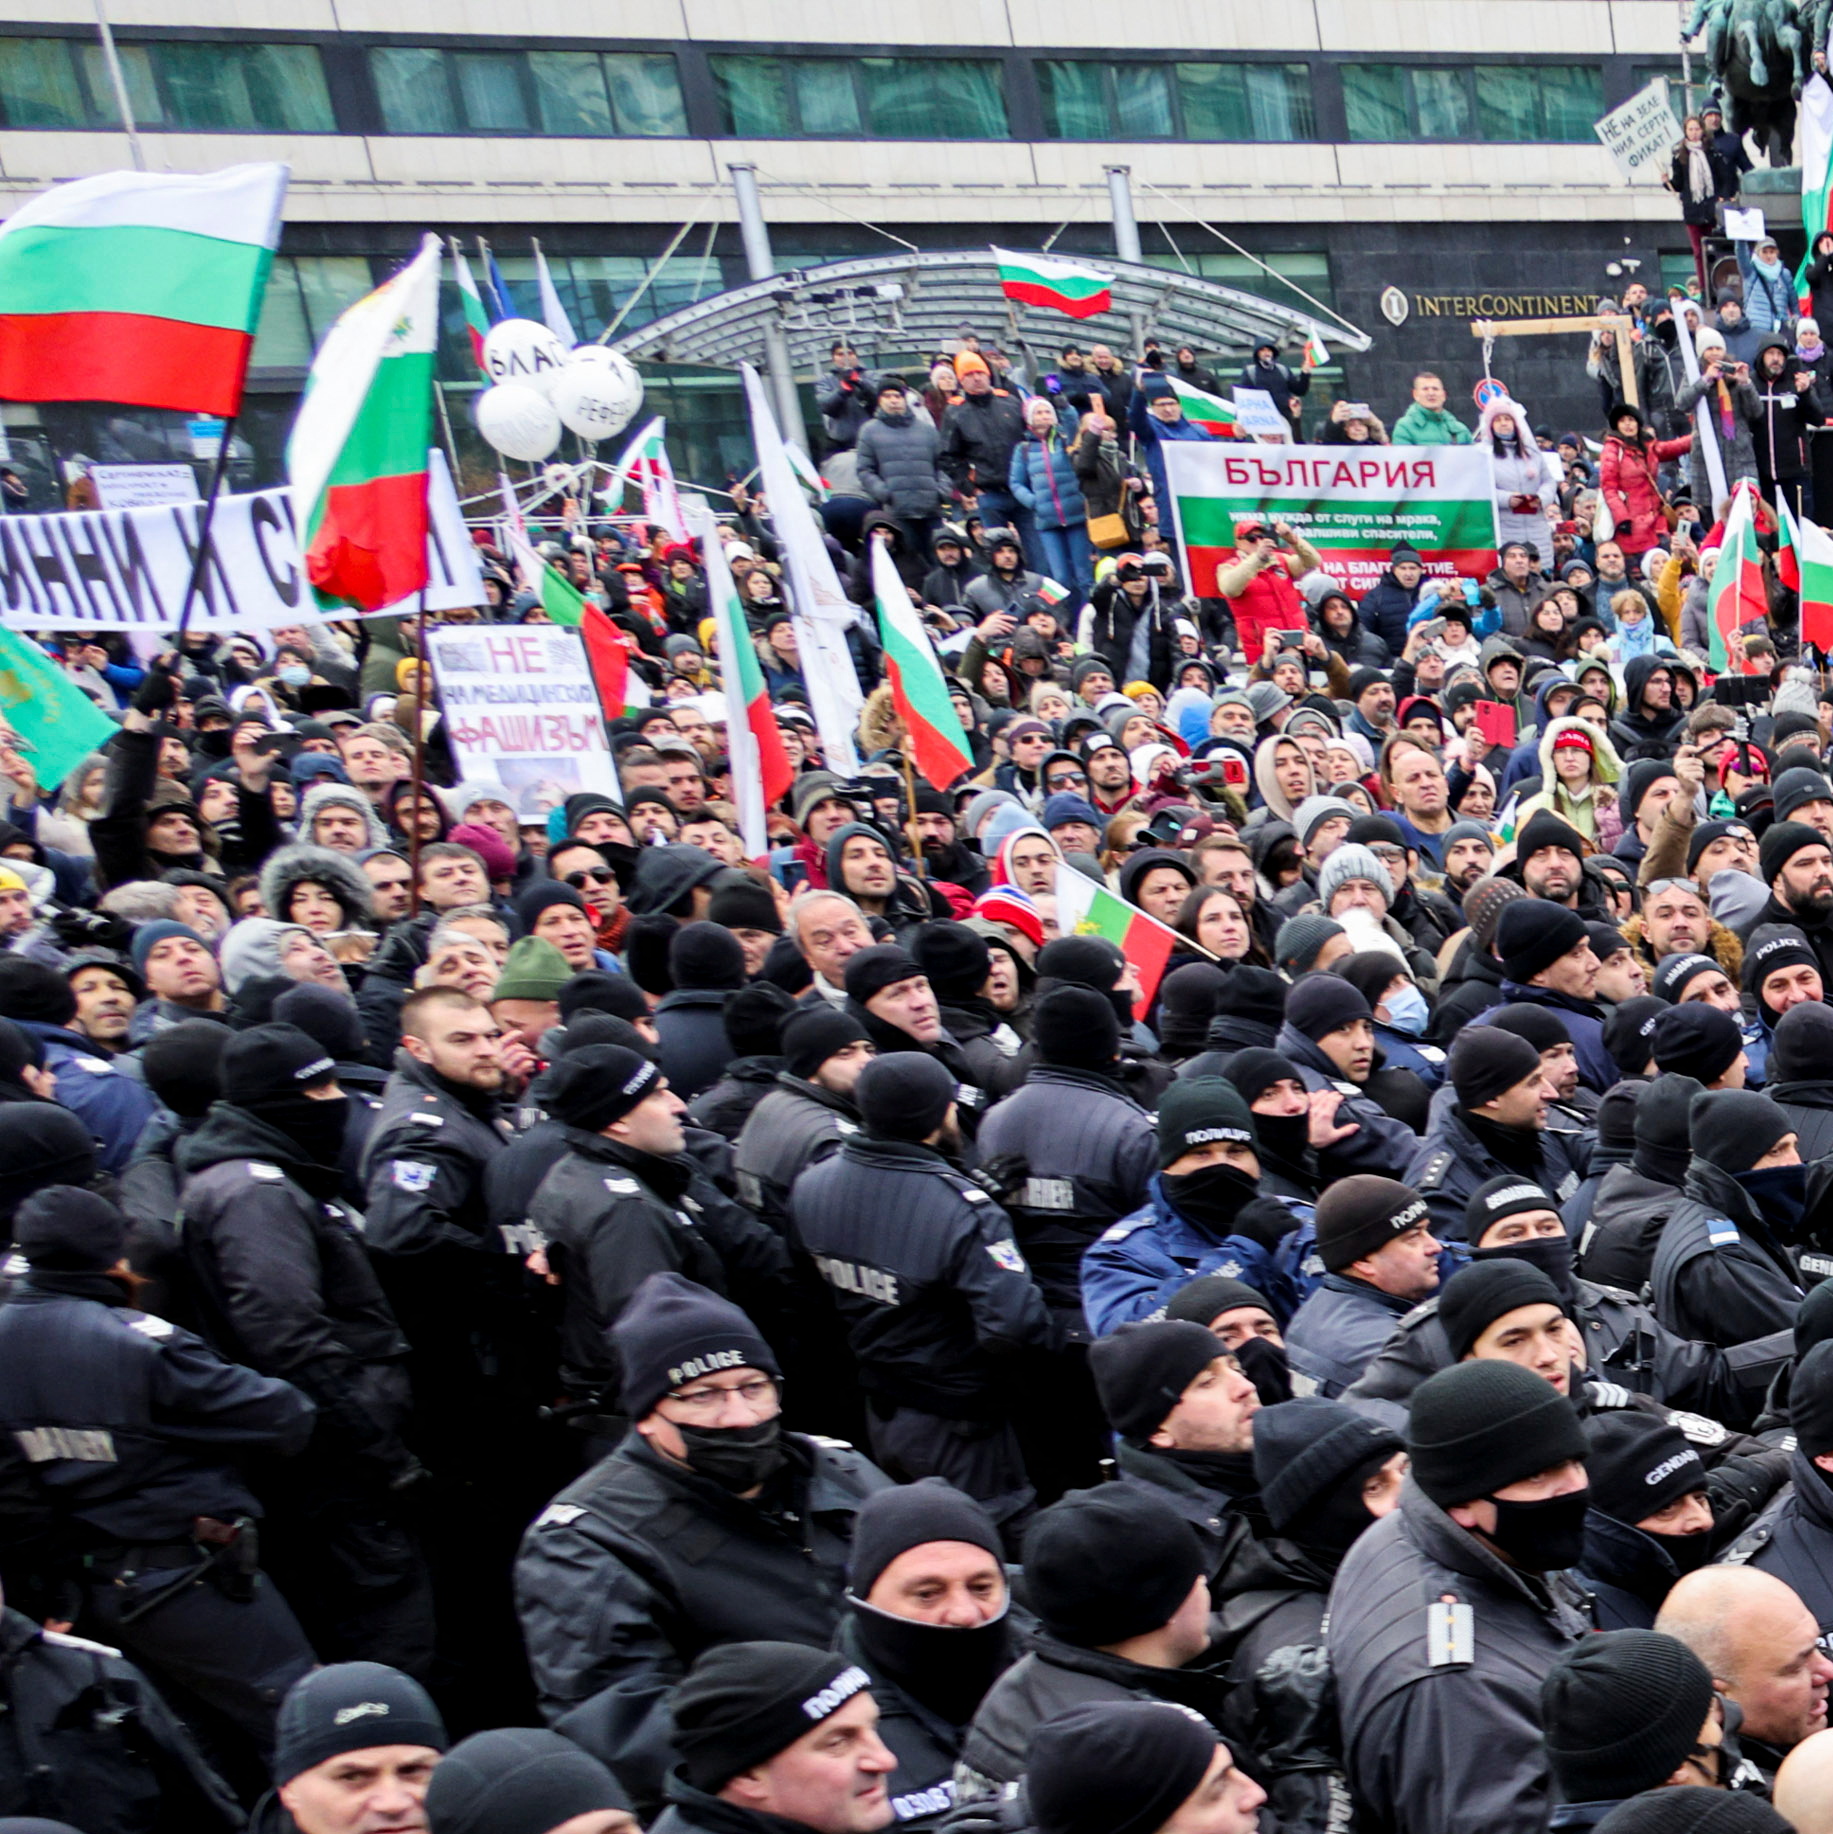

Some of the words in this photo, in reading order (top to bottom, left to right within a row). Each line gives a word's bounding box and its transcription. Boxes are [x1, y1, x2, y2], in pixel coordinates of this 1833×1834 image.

[1601, 121, 1621, 142] НЕ
[1416, 294, 1620, 317] INTERCONTINENT
[1225, 459, 1437, 490] БЪЛГАРИЯ
[489, 635, 546, 671] НЕ
[450, 713, 612, 752] ФАШИЗЪМ
[1754, 937, 1800, 960] POLICE
[667, 1348, 746, 1387] POLICE
